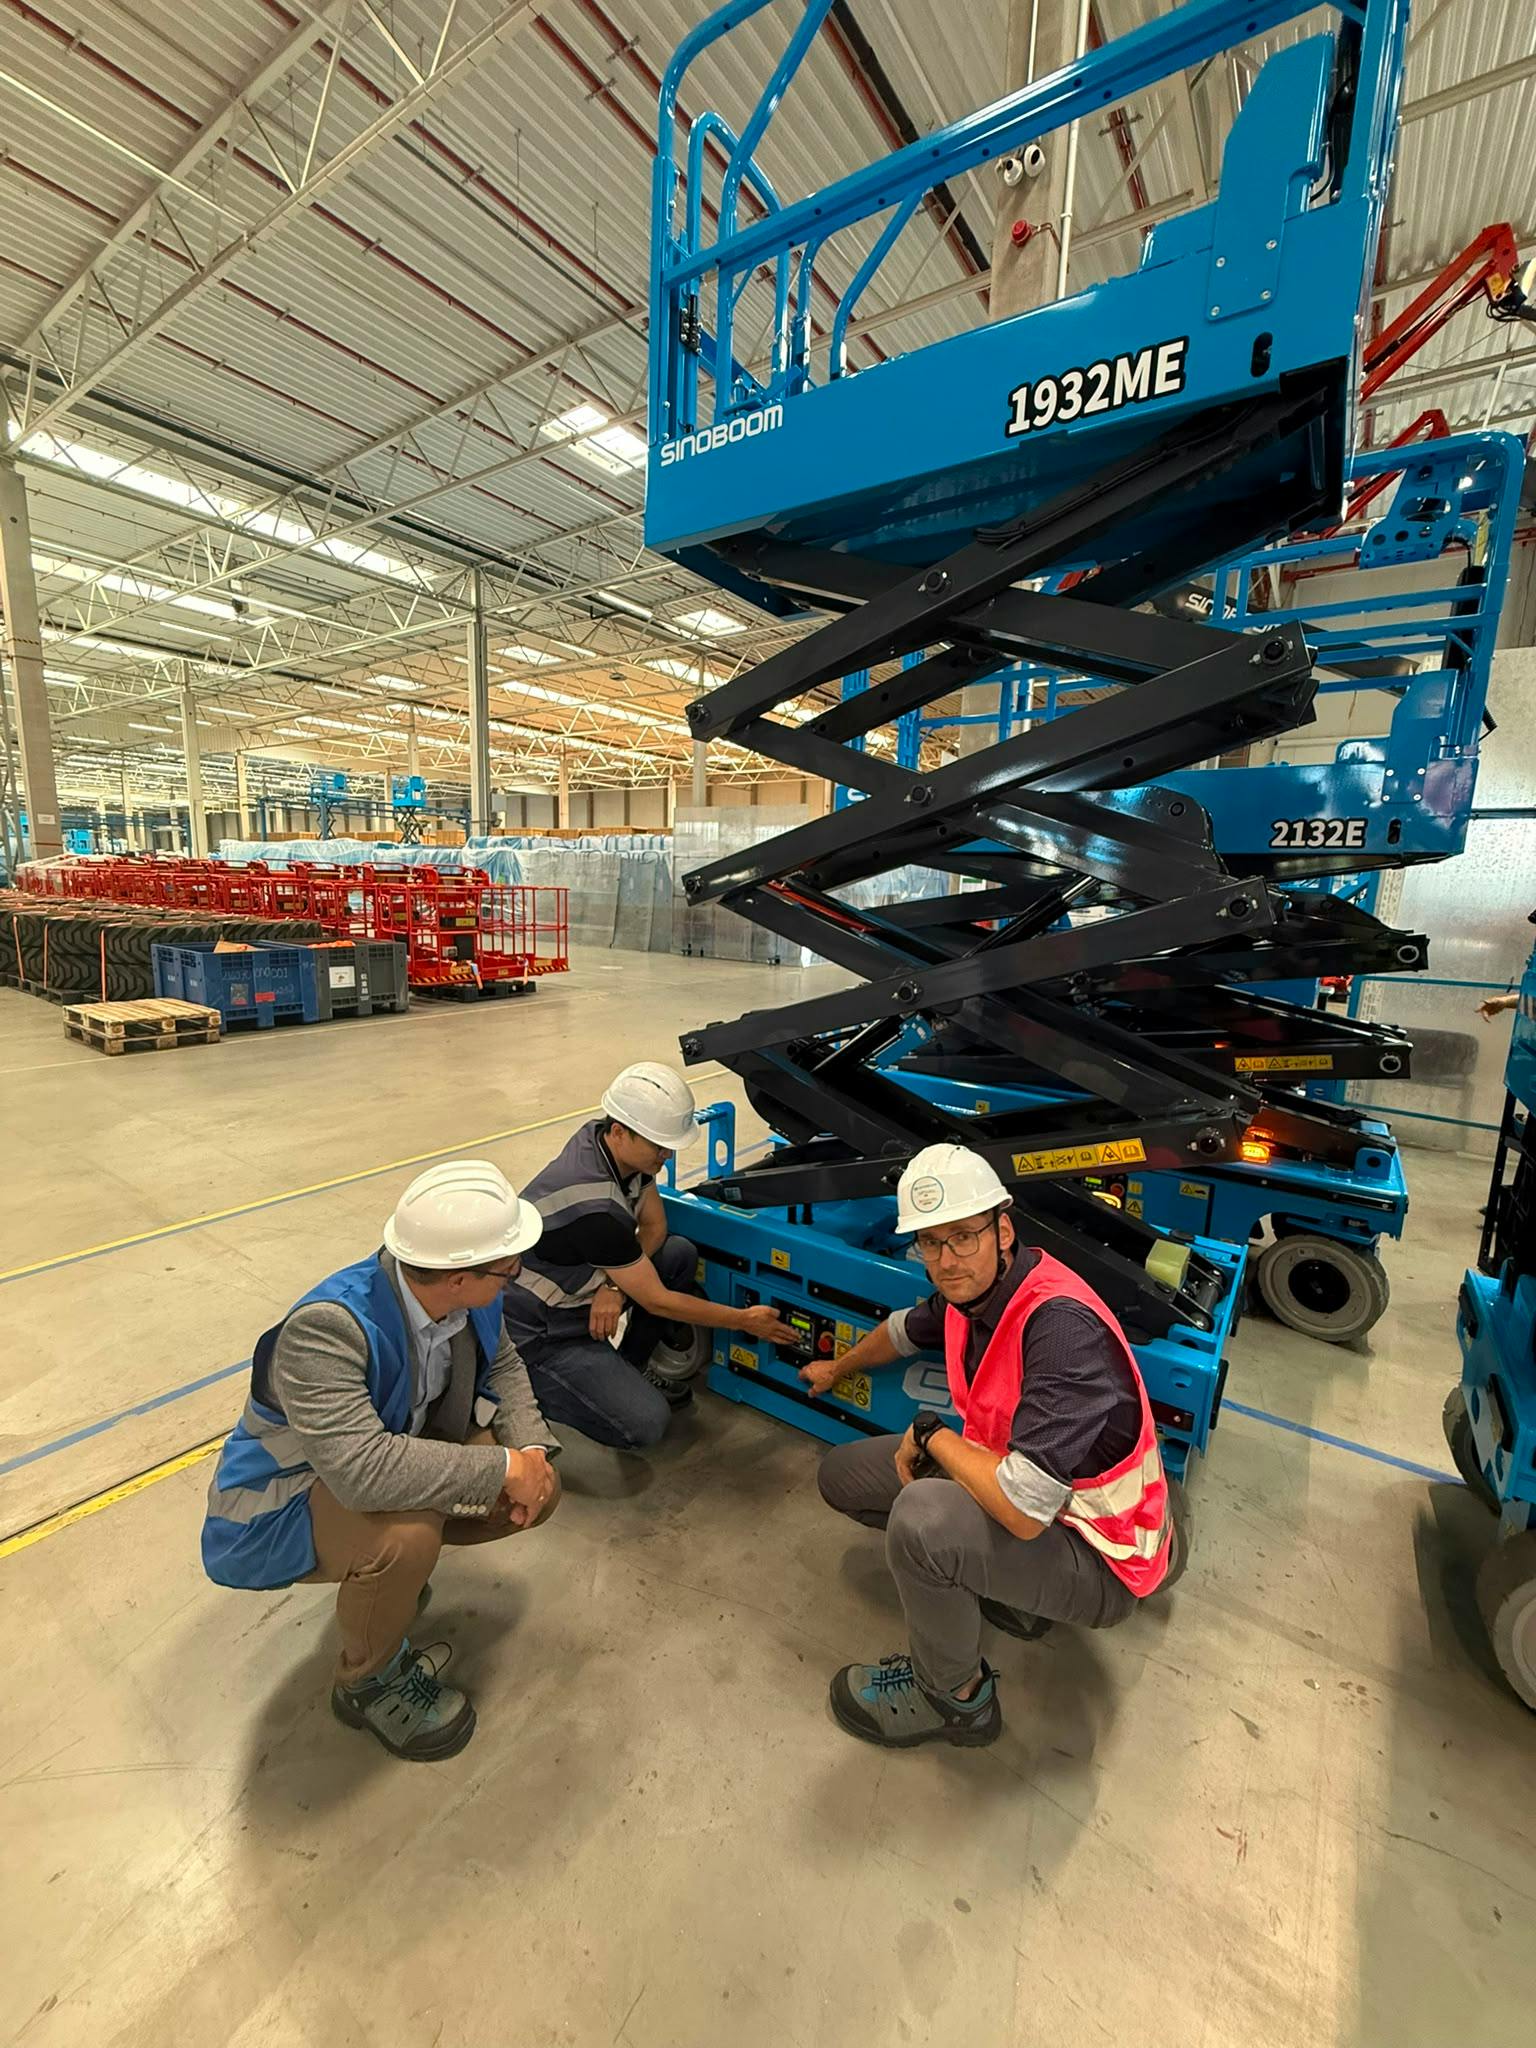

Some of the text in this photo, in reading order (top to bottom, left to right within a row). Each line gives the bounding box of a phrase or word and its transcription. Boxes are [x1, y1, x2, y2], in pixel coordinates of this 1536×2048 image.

[1006, 338, 1187, 436] 1932ME
[660, 404, 784, 467] SINOBOOM
[1270, 819, 1366, 848] 2132E
